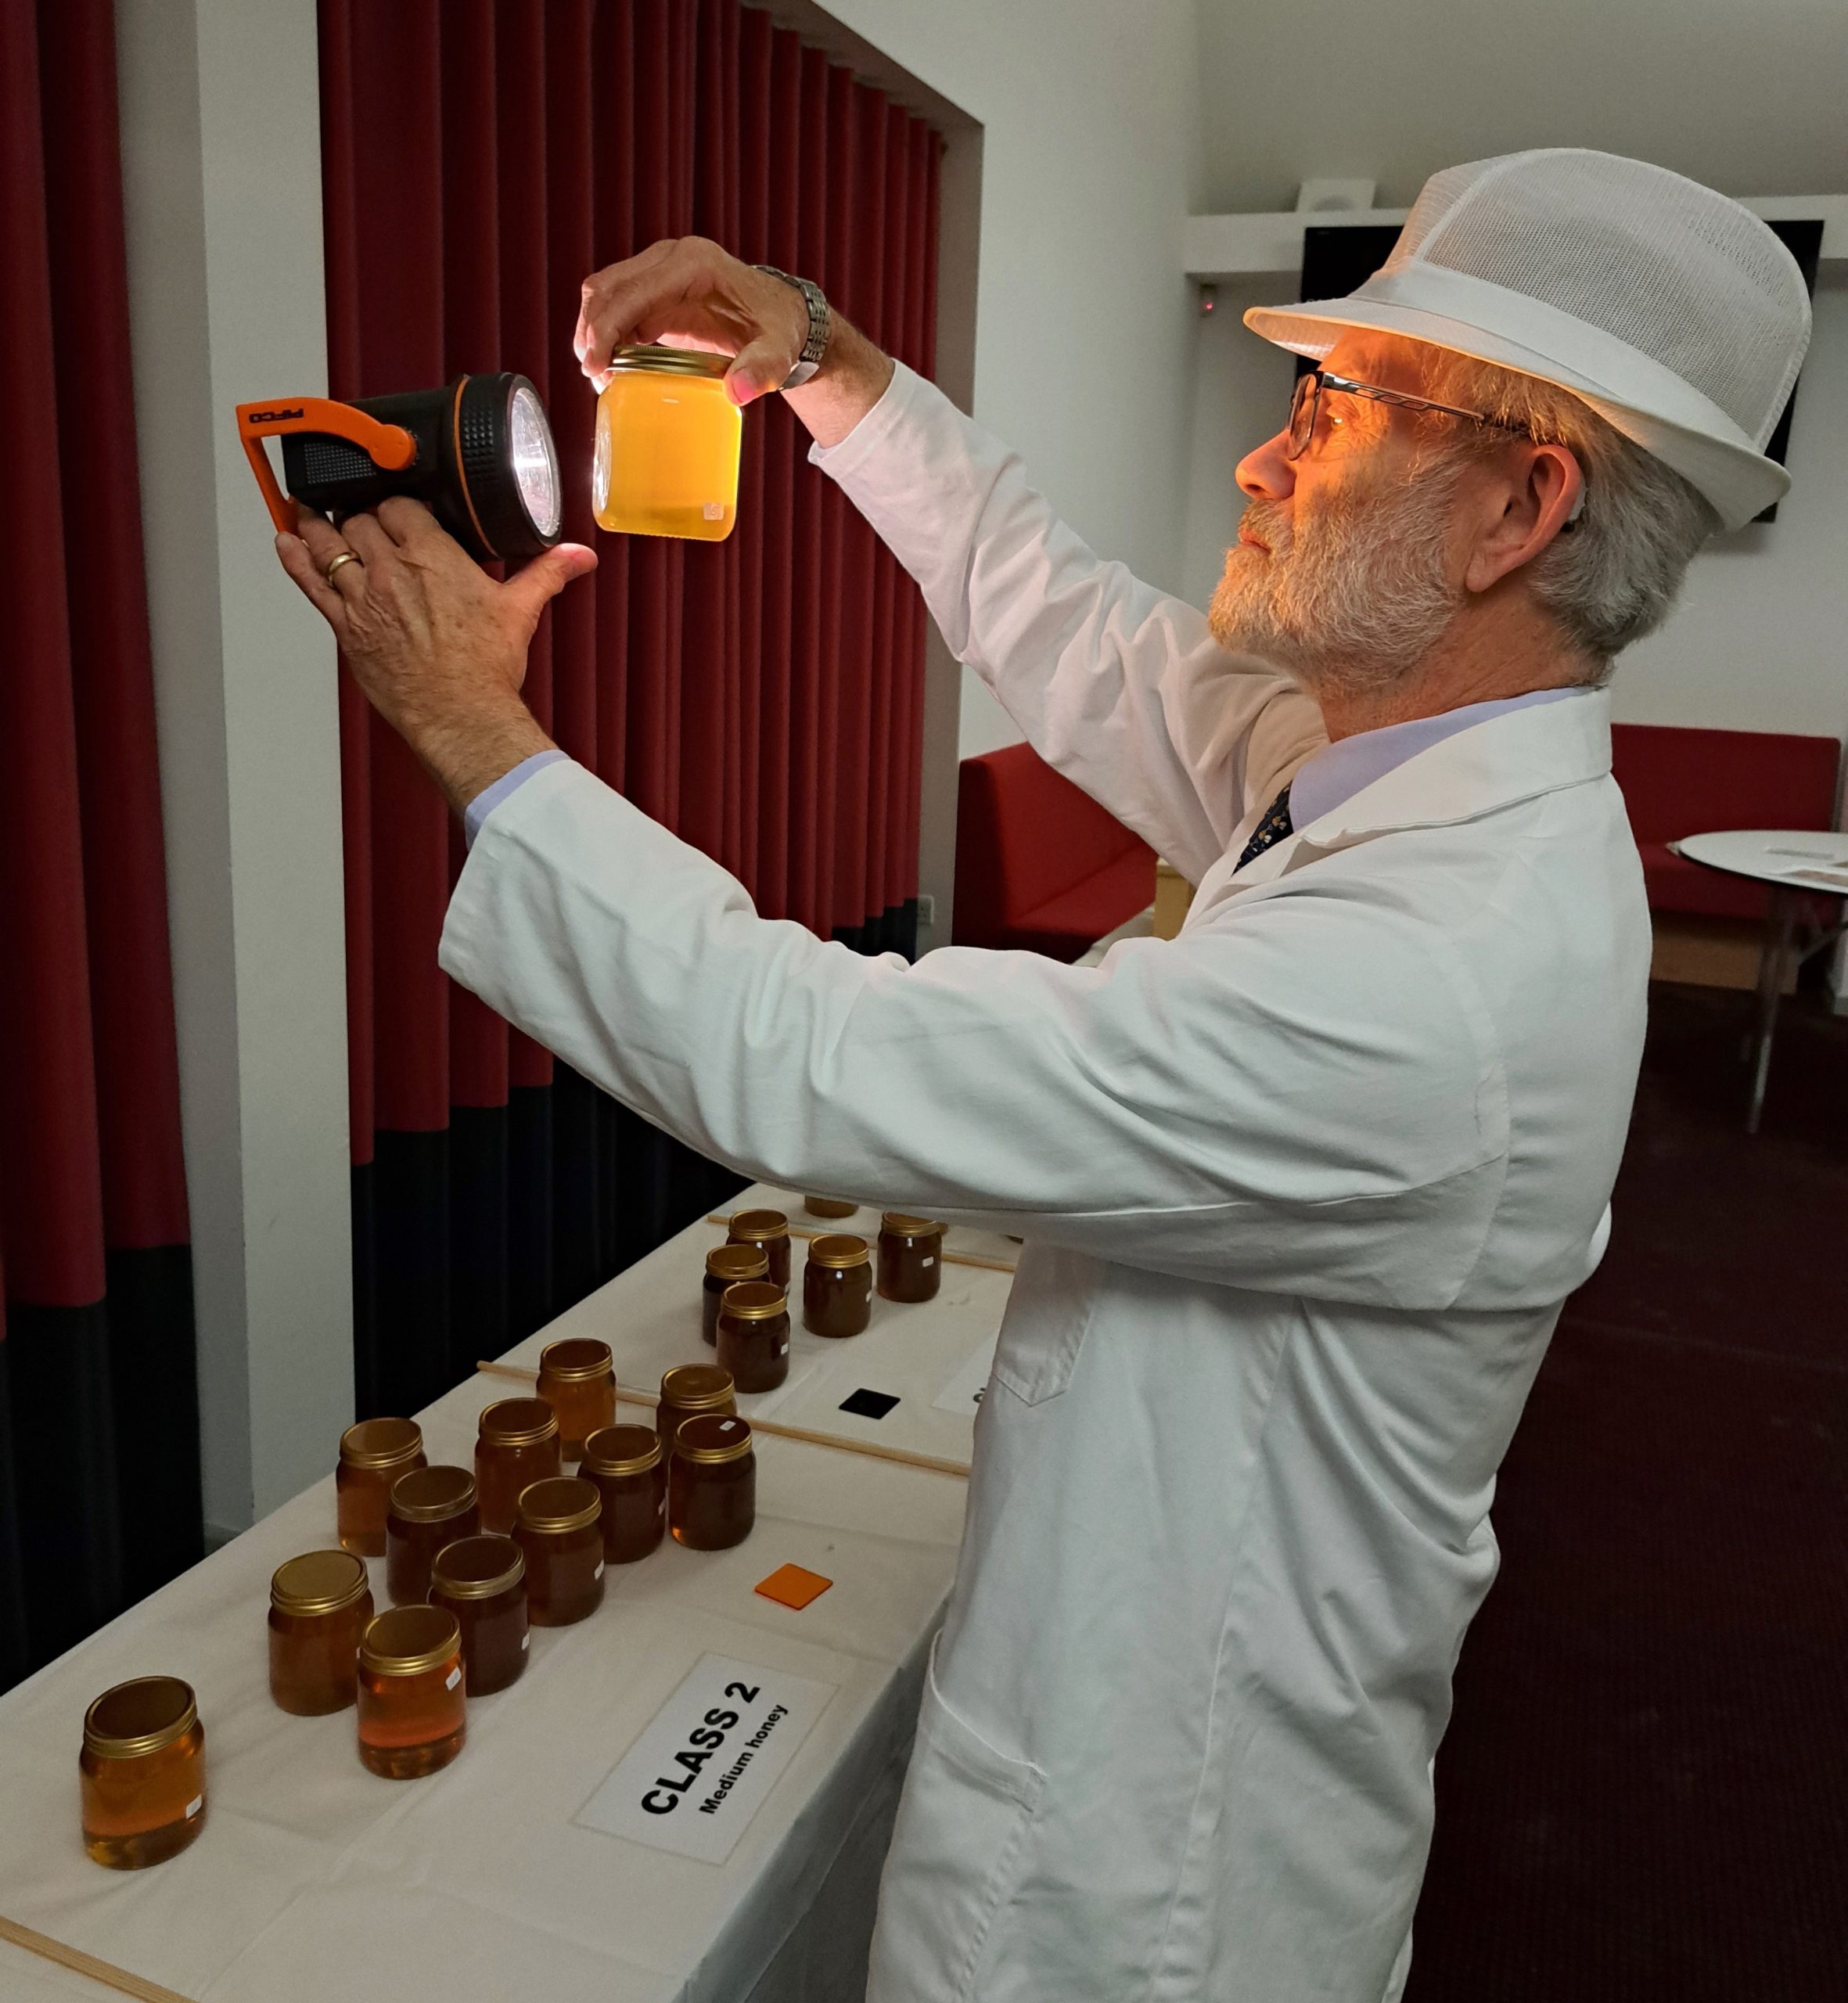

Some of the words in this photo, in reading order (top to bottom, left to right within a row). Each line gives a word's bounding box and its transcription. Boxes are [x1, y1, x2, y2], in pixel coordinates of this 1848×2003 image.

[249, 408, 304, 423] PIFCO
[641, 1708, 739, 1814] CLASS
[724, 1681, 761, 1703] 2
[699, 1751, 754, 1814] Medium
[745, 1704, 789, 1749] honey
